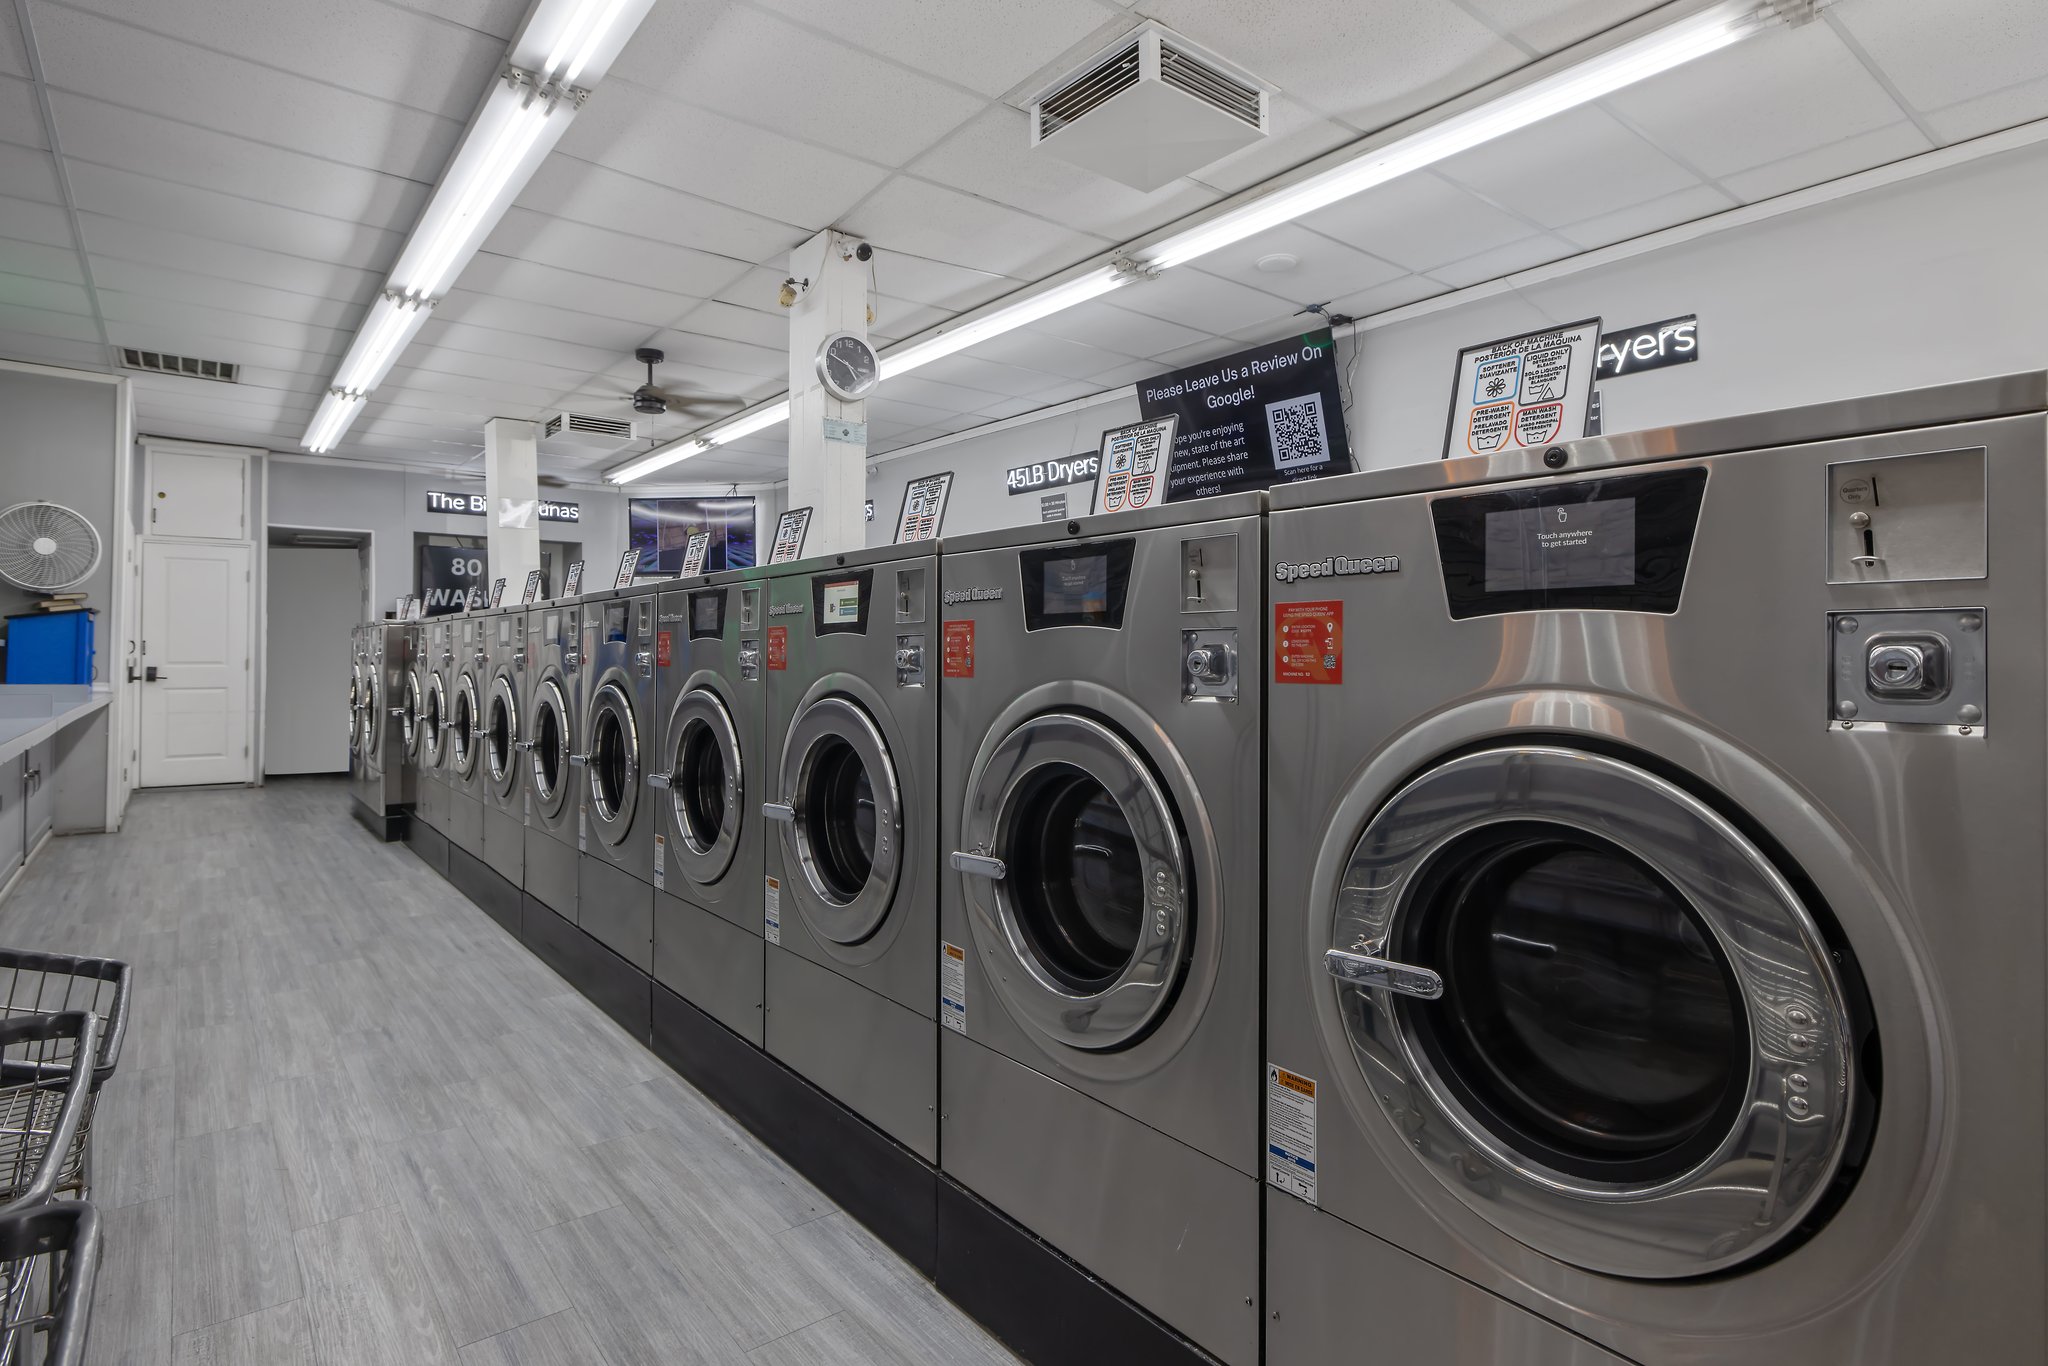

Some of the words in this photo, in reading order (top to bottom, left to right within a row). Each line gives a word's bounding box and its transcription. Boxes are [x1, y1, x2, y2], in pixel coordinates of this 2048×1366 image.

[1474, 348, 1518, 364] POSTERIOR
[1518, 345, 1530, 354] DE
[1543, 335, 1582, 348] MAQUINA
[1491, 343, 1513, 354] BACK
[1526, 332, 1564, 345] MACHINE
[1526, 352, 1549, 362] LIQUID
[1550, 348, 1569, 356] ONLY
[1479, 367, 1518, 380] SUAVIZANTE
[1482, 361, 1516, 372] SOFTENER
[1540, 364, 1567, 374] LIQUIDOS
[1146, 384, 1184, 402] Please
[1184, 374, 1219, 393] Leave
[1221, 368, 1238, 382] Us
[1242, 366, 1248, 378] a
[1250, 352, 1298, 376] Review
[1302, 346, 1322, 362] On
[1207, 385, 1255, 409] Google!
[1472, 412, 1511, 423] DETERGENT
[1476, 406, 1510, 416] PRE-WASH
[1520, 412, 1557, 422] DETERGENT
[1522, 408, 1538, 416] MAIN
[1472, 426, 1508, 436] DETERGENTE
[1474, 420, 1508, 430] PRELAVADO
[1522, 424, 1552, 432] DETERGENTE
[1188, 429, 1210, 444] you're
[1212, 422, 1244, 436] enjoying
[1174, 448, 1190, 458] new,
[1192, 444, 1210, 455] state
[1210, 440, 1218, 450] of
[1220, 440, 1232, 449] the
[1234, 437, 1246, 446] art
[1202, 456, 1226, 466] Please
[1227, 451, 1248, 462] share
[1007, 464, 1044, 488] 45LB
[1048, 457, 1098, 482] Dryers
[1170, 477, 1186, 488] your
[1188, 470, 1226, 484] experience
[1227, 466, 1244, 476] with
[1196, 484, 1222, 496] others!
[428, 492, 465, 510] The
[1559, 530, 1593, 538] anywhere
[451, 558, 482, 576] 80
[1275, 557, 1334, 584] Speed
[1334, 555, 1400, 576] Queen
[944, 588, 971, 606] Speed
[971, 587, 1002, 601] Queen
